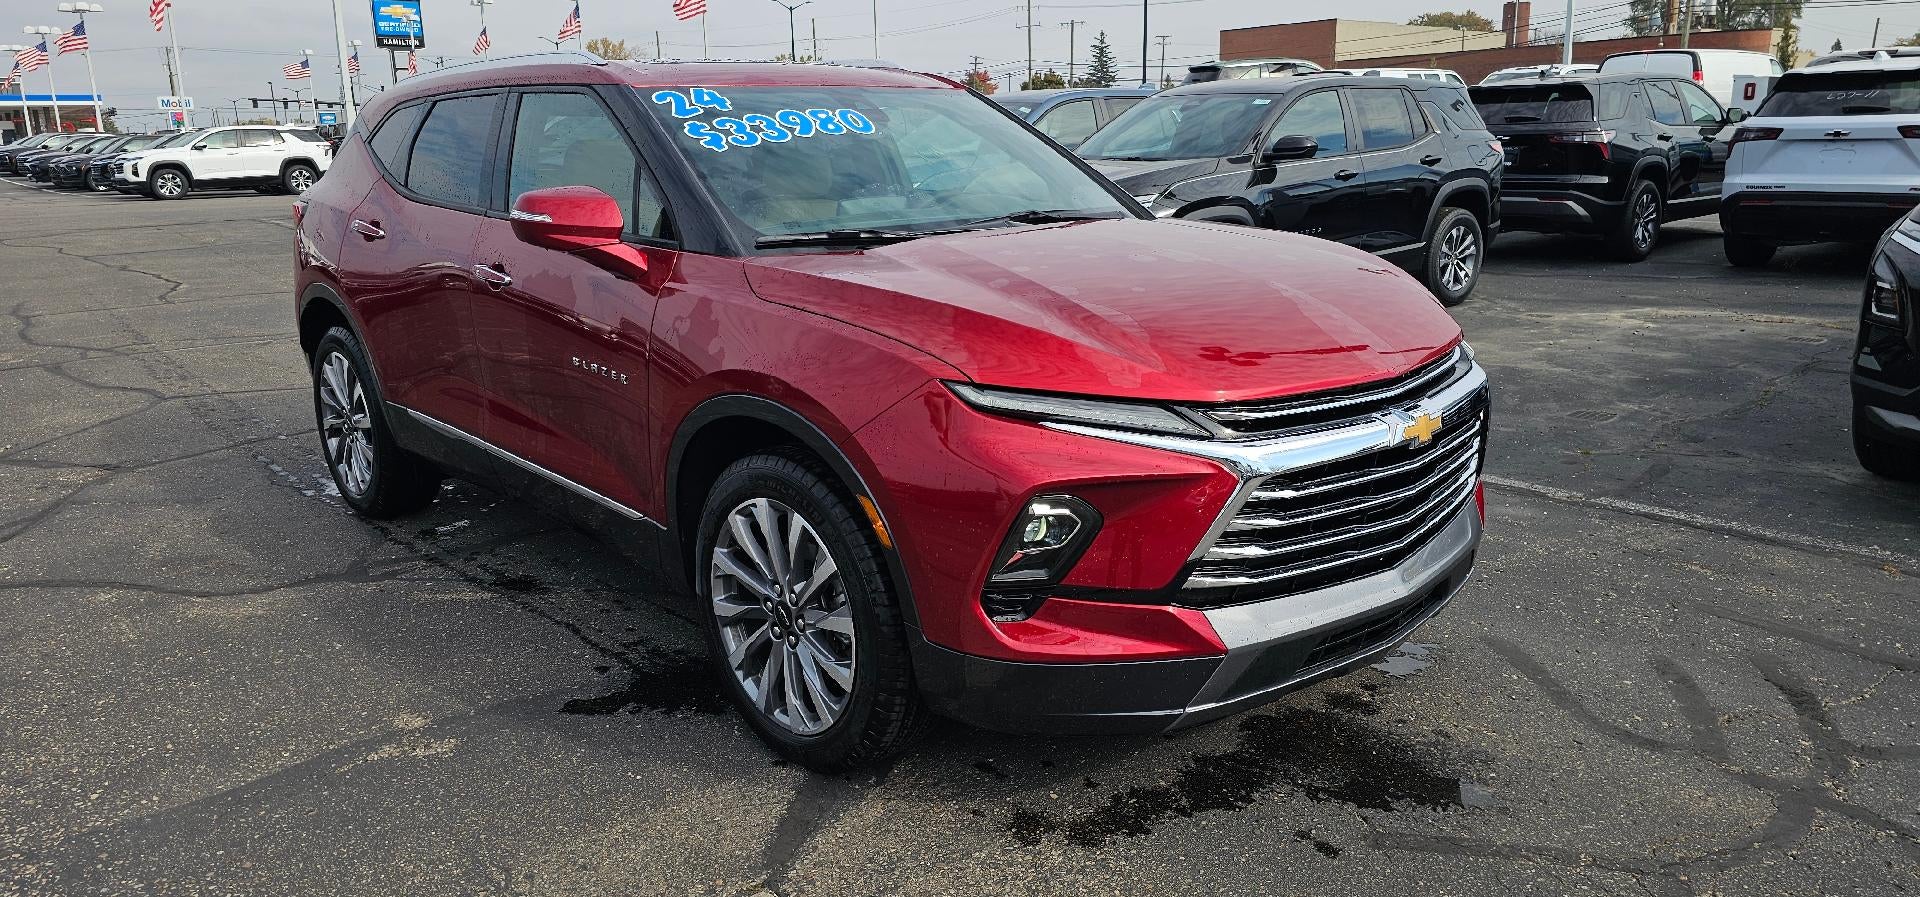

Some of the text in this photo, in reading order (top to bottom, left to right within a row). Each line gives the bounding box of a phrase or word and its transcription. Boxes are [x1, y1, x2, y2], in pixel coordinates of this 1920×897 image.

[383, 38, 420, 46] HAMILTON
[161, 99, 191, 108] Mobil
[651, 87, 733, 118] 24
[684, 108, 876, 152] $33980
[572, 356, 629, 386] BLAZER
